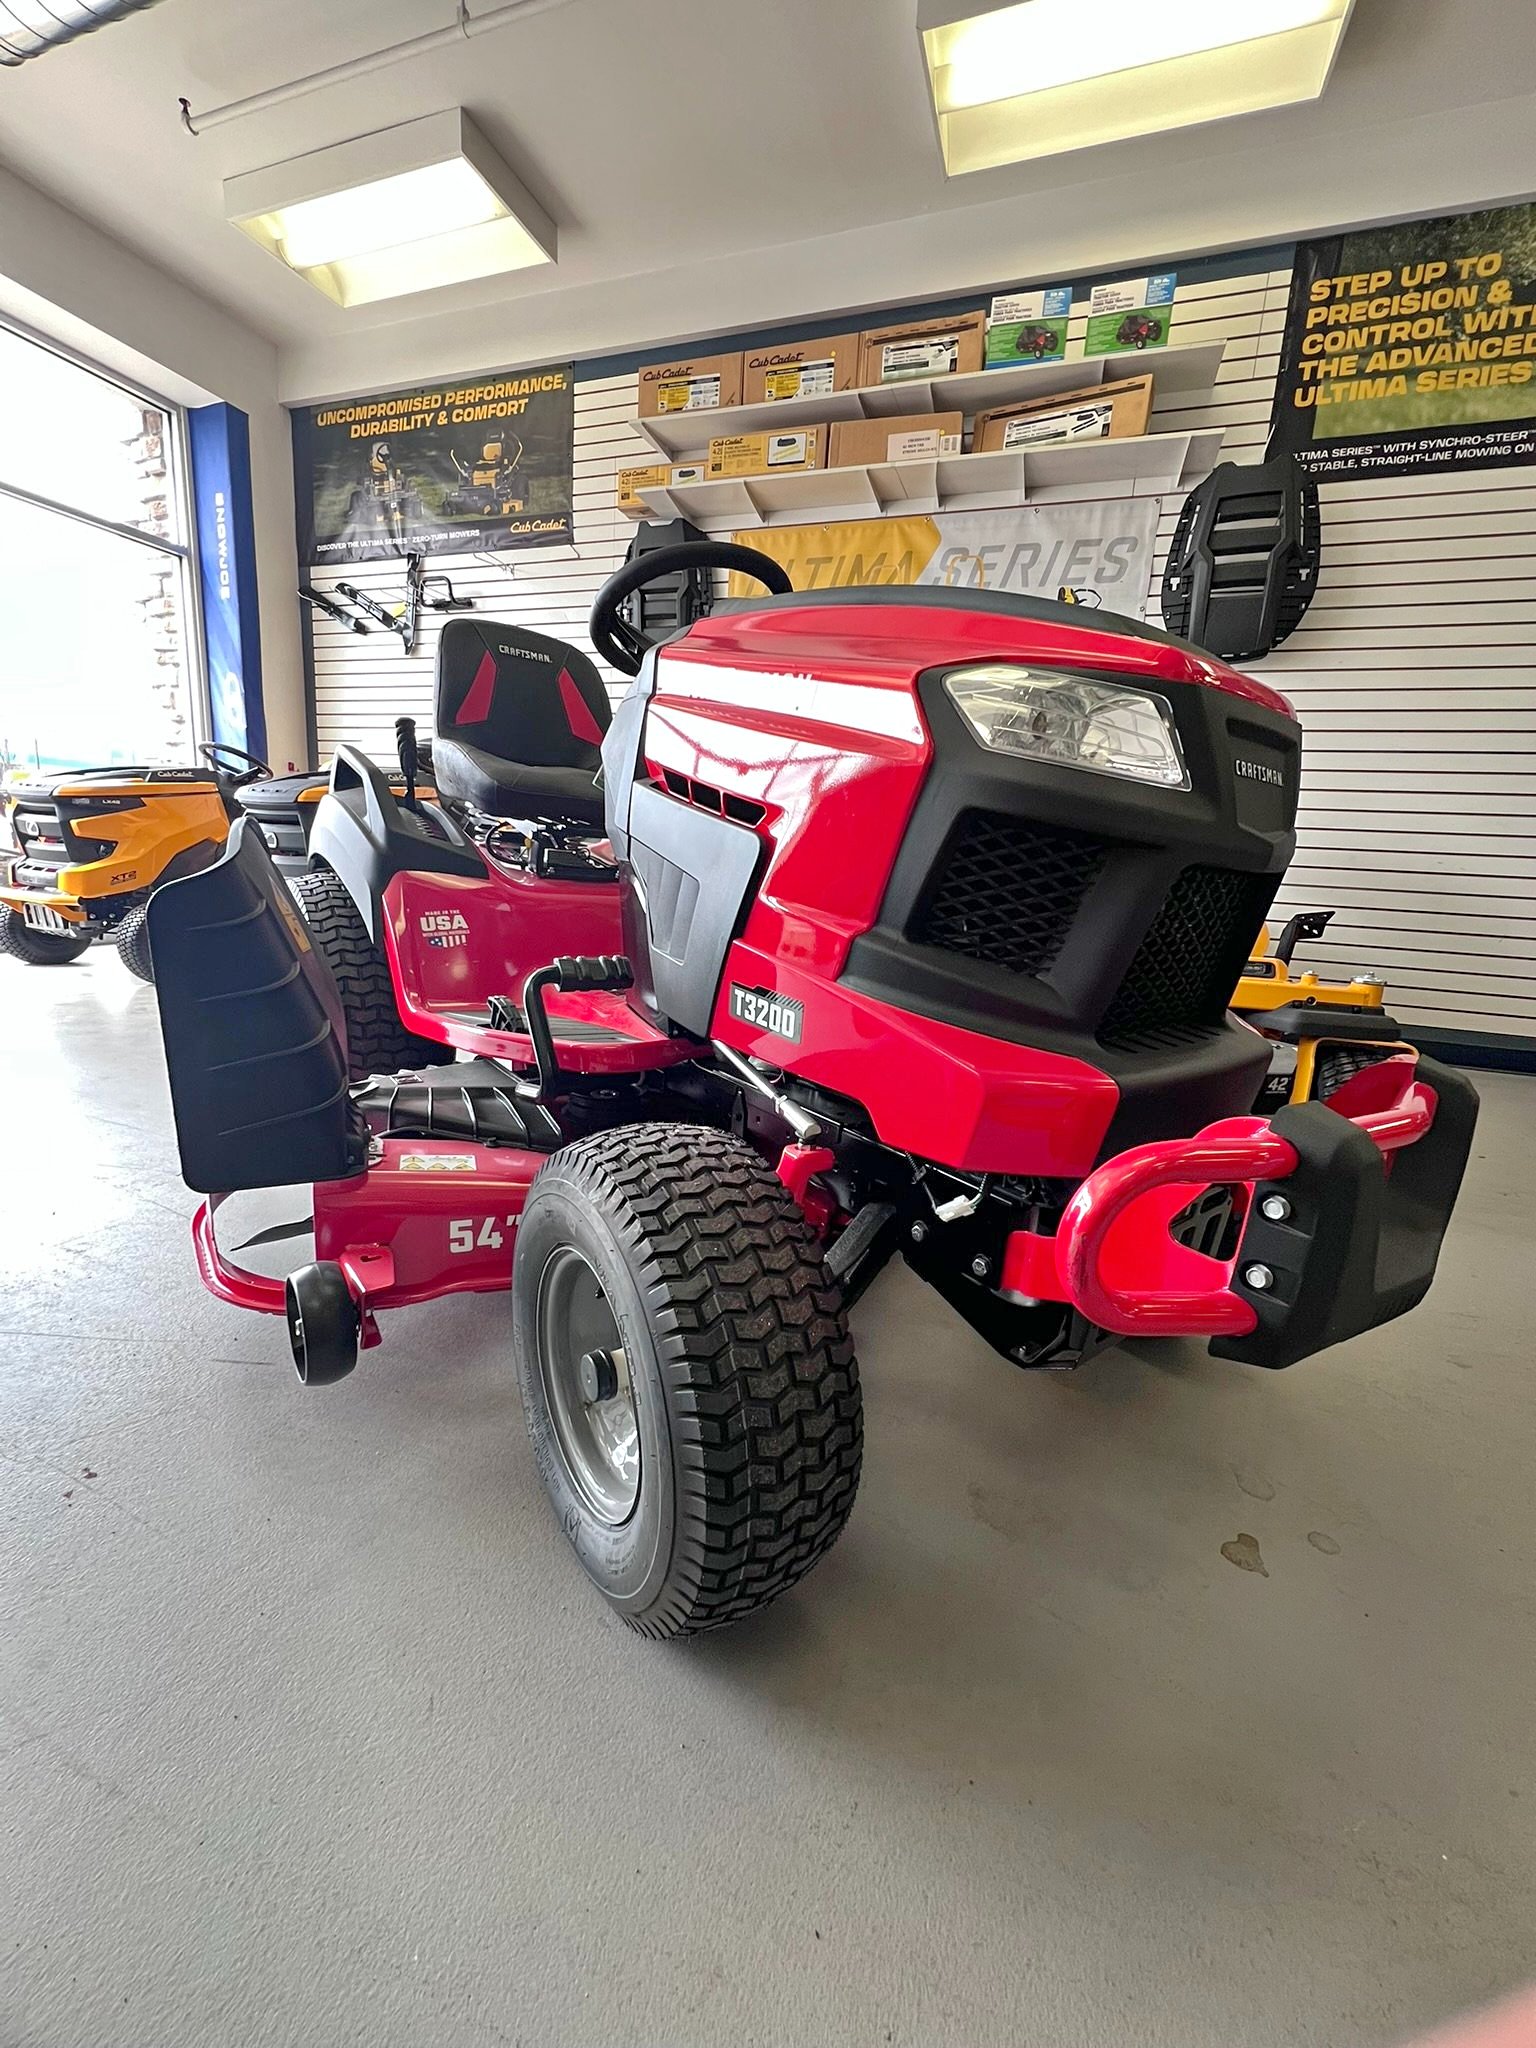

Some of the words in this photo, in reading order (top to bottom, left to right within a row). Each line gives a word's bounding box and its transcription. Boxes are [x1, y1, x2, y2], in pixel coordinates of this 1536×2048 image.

[1309, 269, 1393, 302] STEP
[1400, 261, 1448, 288] UP
[1456, 252, 1503, 280] TO
[1305, 285, 1479, 330] PRECISION
[1486, 279, 1514, 305] &
[1302, 314, 1455, 356] CONTROL
[1293, 374, 1408, 409] ULTIMA
[1415, 360, 1533, 394] SERIES
[1298, 354, 1360, 382] THE
[316, 393, 442, 428] UNCOMPROMISED
[444, 373, 568, 406] PERFORMANCE,
[350, 412, 434, 440] DURABILITY
[437, 411, 449, 427] &
[451, 398, 530, 424] COMFORT
[1309, 458, 1358, 473] STABLE,
[1360, 450, 1453, 468] STRAIGHT-LINE
[1455, 445, 1512, 460] MOWING
[1514, 442, 1535, 454] ON
[1383, 440, 1417, 454] WITH
[317, 541, 347, 552] DISCOVER
[347, 540, 359, 549] THE
[360, 537, 384, 548] ULTIMA
[412, 532, 448, 544] ZERO-TURN
[449, 528, 480, 540] MOWERS
[510, 520, 531, 534] Cub
[531, 517, 567, 532] Cadet
[744, 550, 913, 598] TIMA
[932, 535, 1139, 589] SERIES
[498, 644, 551, 663] CRAFTSMAN
[1235, 759, 1284, 786] CRAFTSMAN
[419, 914, 469, 932] USA
[734, 988, 796, 1039] T3200
